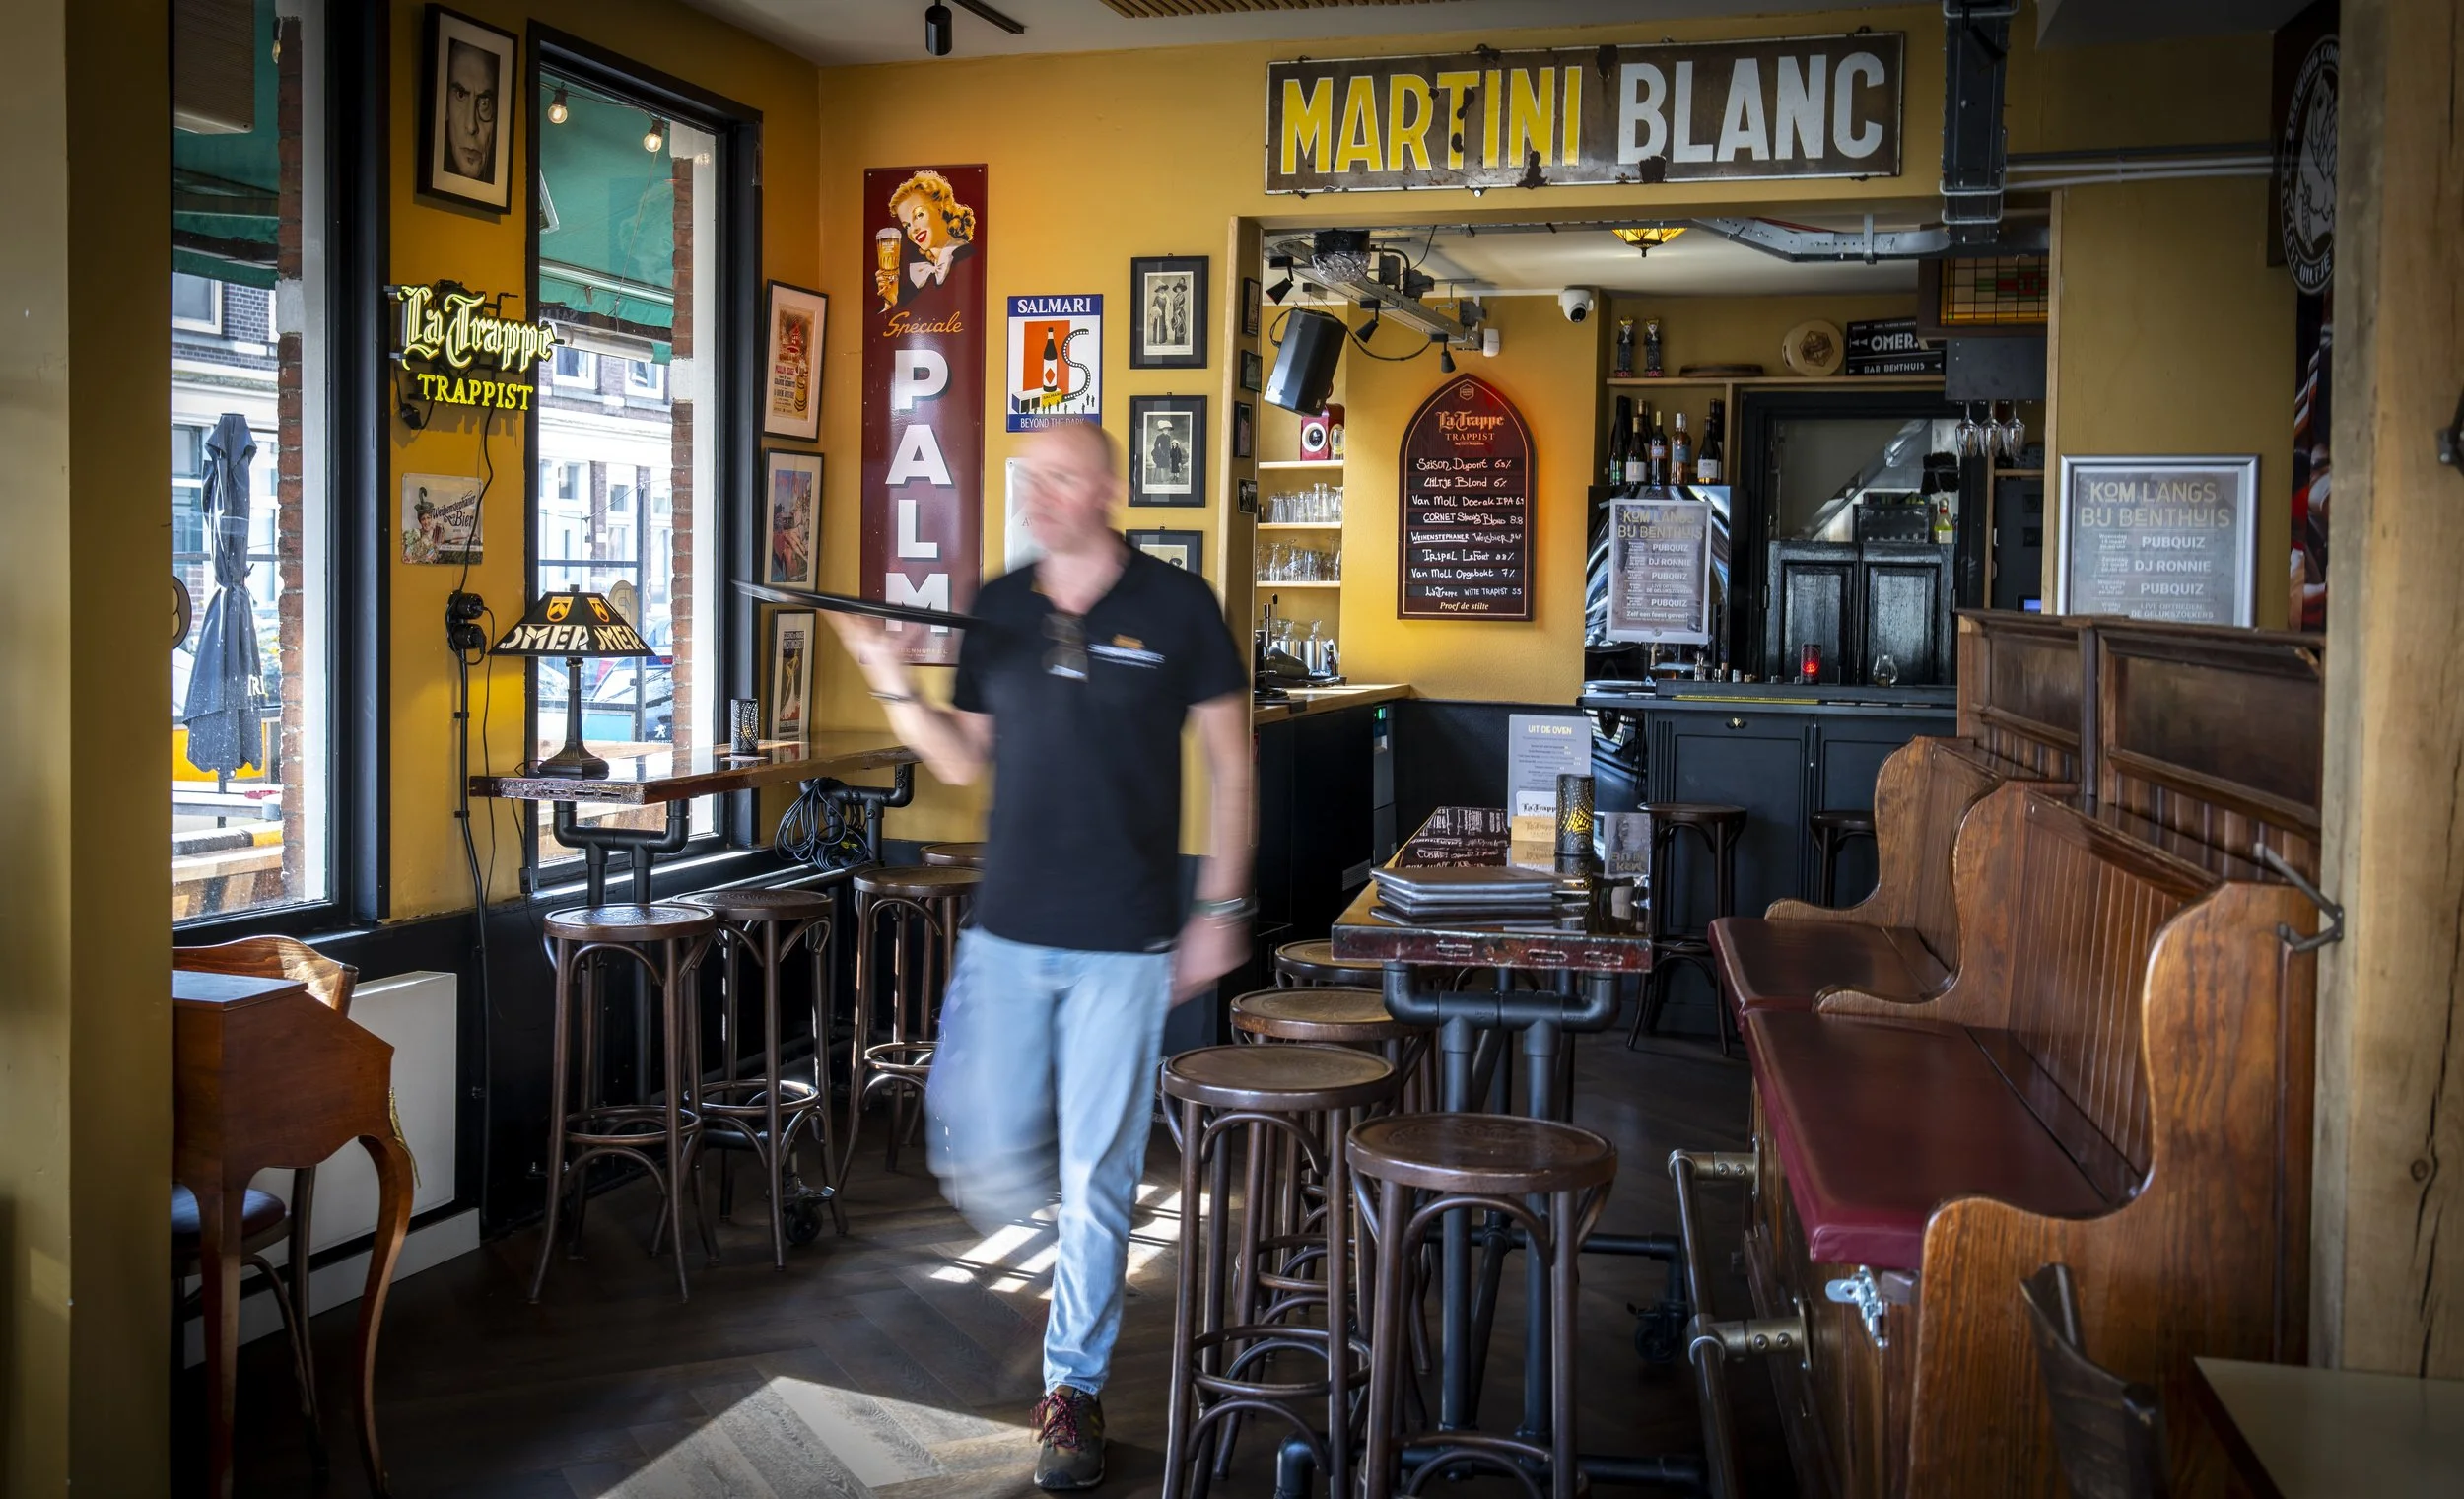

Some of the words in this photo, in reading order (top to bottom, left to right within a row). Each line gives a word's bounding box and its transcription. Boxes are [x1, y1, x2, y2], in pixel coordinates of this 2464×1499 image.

[1280, 65, 1583, 175] MARTINI
[1617, 51, 1884, 166] BLANC
[2300, 254, 2331, 285] UILTJE
[1017, 298, 1091, 314] SALMARI
[882, 310, 964, 339] Spéciale
[445, 293, 556, 373] Trappe
[1864, 366, 1881, 375] BAR
[1883, 362, 1925, 374] BENTHUIS
[417, 373, 534, 410] TRAPPIST
[1020, 417, 1050, 429] BEYOND
[1051, 417, 1064, 428] THE
[1455, 410, 1505, 432] Trappe
[1445, 432, 1495, 442] TRAPPIST
[1416, 457, 1452, 471] Saison
[1452, 457, 1488, 471] Dupont
[1493, 478, 1508, 488] 6%
[885, 349, 952, 634] PALM
[2090, 482, 2136, 504] KOM
[2142, 482, 2217, 504] LANGS
[1412, 494, 1430, 506] Van
[1434, 495, 1458, 507] Moll
[1462, 496, 1495, 507] Doerak
[1495, 497, 1514, 506] IPA
[448, 510, 474, 527] Bier
[1422, 513, 1456, 523] CORNET
[1623, 511, 1650, 523] KOM
[1652, 511, 1695, 524] LANGS
[2119, 507, 2231, 528] BENTHUIS
[1640, 525, 1703, 539] BENTHUIS
[1652, 543, 1689, 553] PUBQUIZ
[2142, 535, 2206, 550] PUBQUIZ
[1411, 568, 1428, 579] Van
[1431, 569, 1453, 579] Moll
[1501, 568, 1516, 579] 7%
[2135, 561, 2154, 573] DJ
[2156, 560, 2212, 573] RONNIE
[1651, 572, 1688, 580] PUBQUIZ
[2141, 582, 2204, 596] PUBQUIZ
[1439, 601, 1460, 611] Proef
[1461, 601, 1470, 610] de
[1471, 601, 1489, 610] stilte
[1651, 599, 1688, 608] PUBQUIZ
[1528, 724, 1540, 734] UIT
[1540, 724, 1551, 734] DE
[1551, 725, 1573, 735] OVEN
